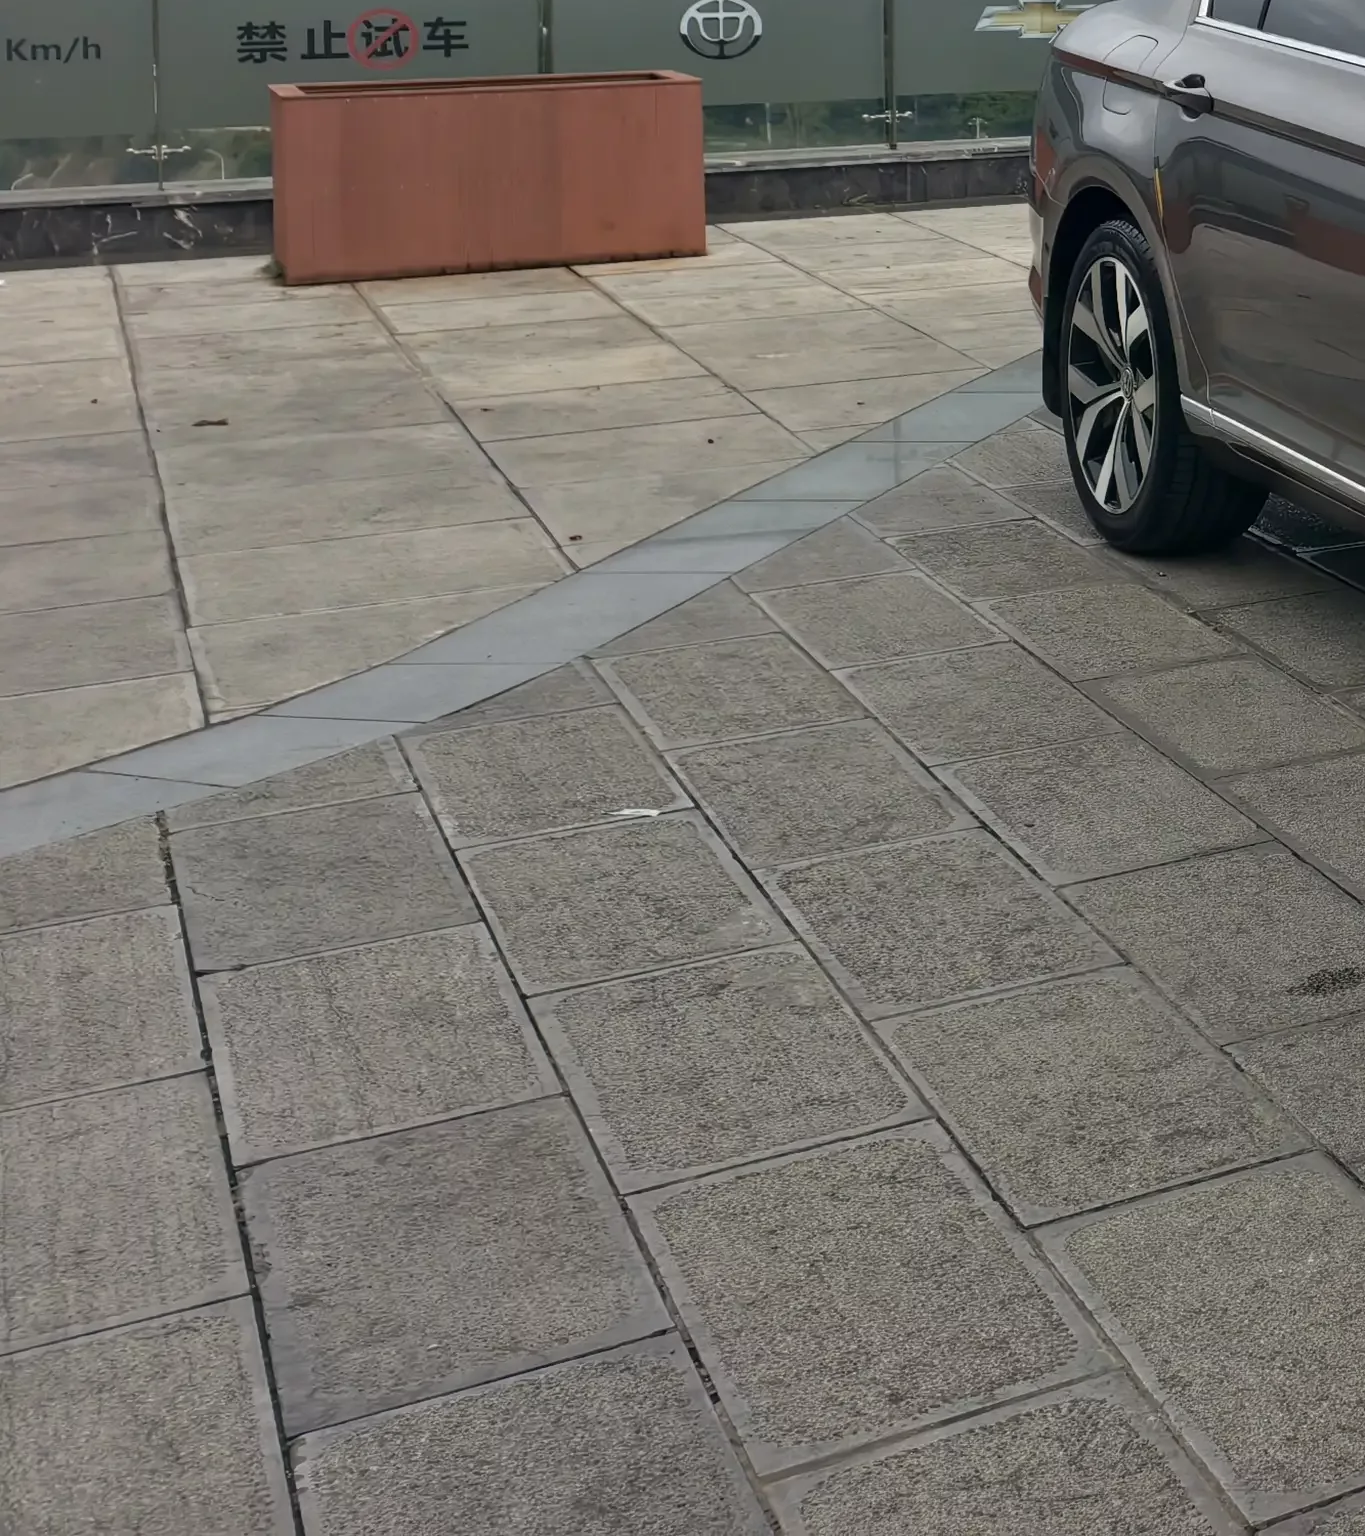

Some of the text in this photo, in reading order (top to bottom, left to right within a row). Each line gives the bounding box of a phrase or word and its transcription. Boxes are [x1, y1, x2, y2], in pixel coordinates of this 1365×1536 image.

[6, 35, 101, 64] Km/h
[236, 16, 469, 64] 禁止试车
